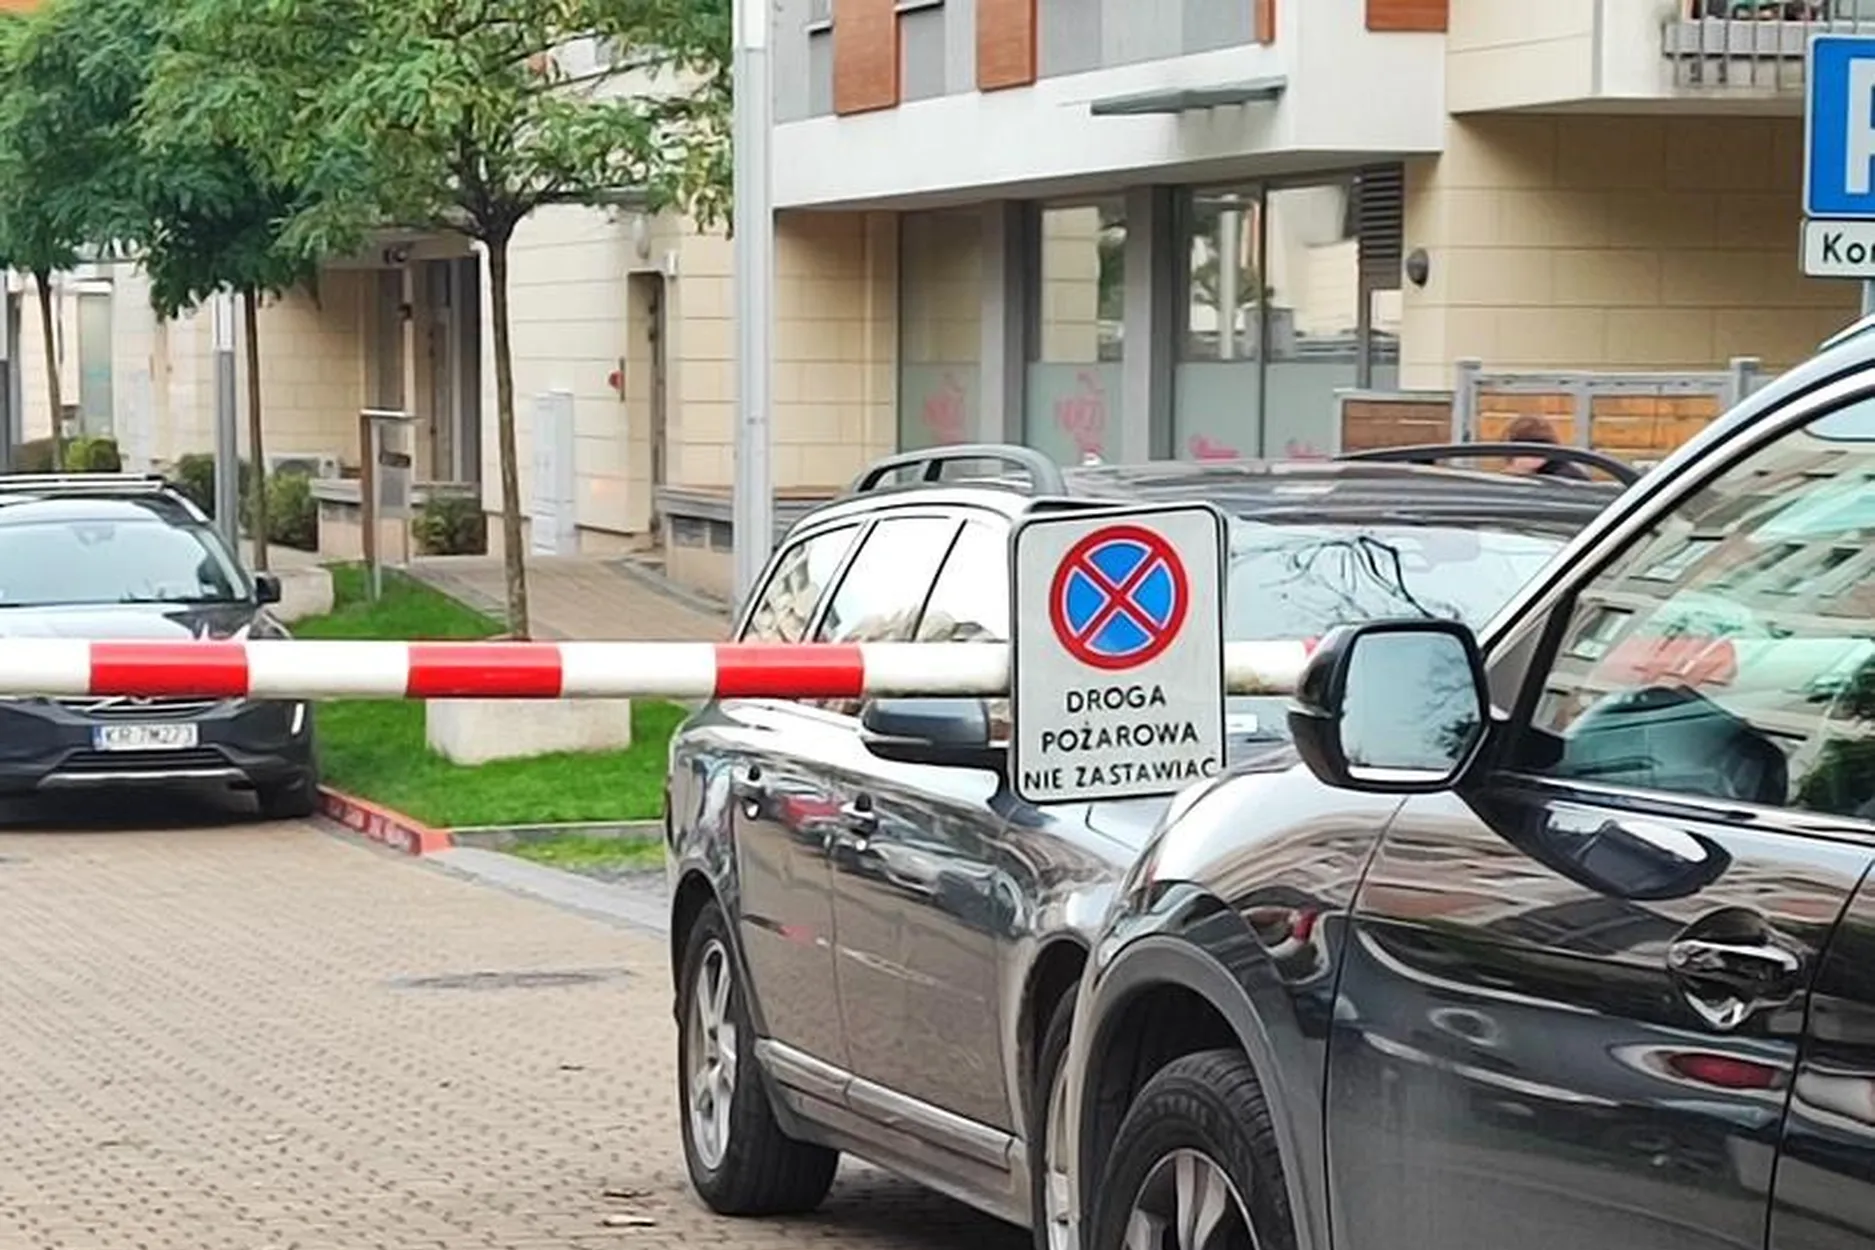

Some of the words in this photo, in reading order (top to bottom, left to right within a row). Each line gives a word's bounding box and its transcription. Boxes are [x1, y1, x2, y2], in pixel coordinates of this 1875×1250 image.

[1823, 231, 1875, 264] Ko
[1066, 685, 1167, 713] DROGA
[1041, 721, 1199, 753] POŻAROWA
[1023, 767, 1062, 790] NIE
